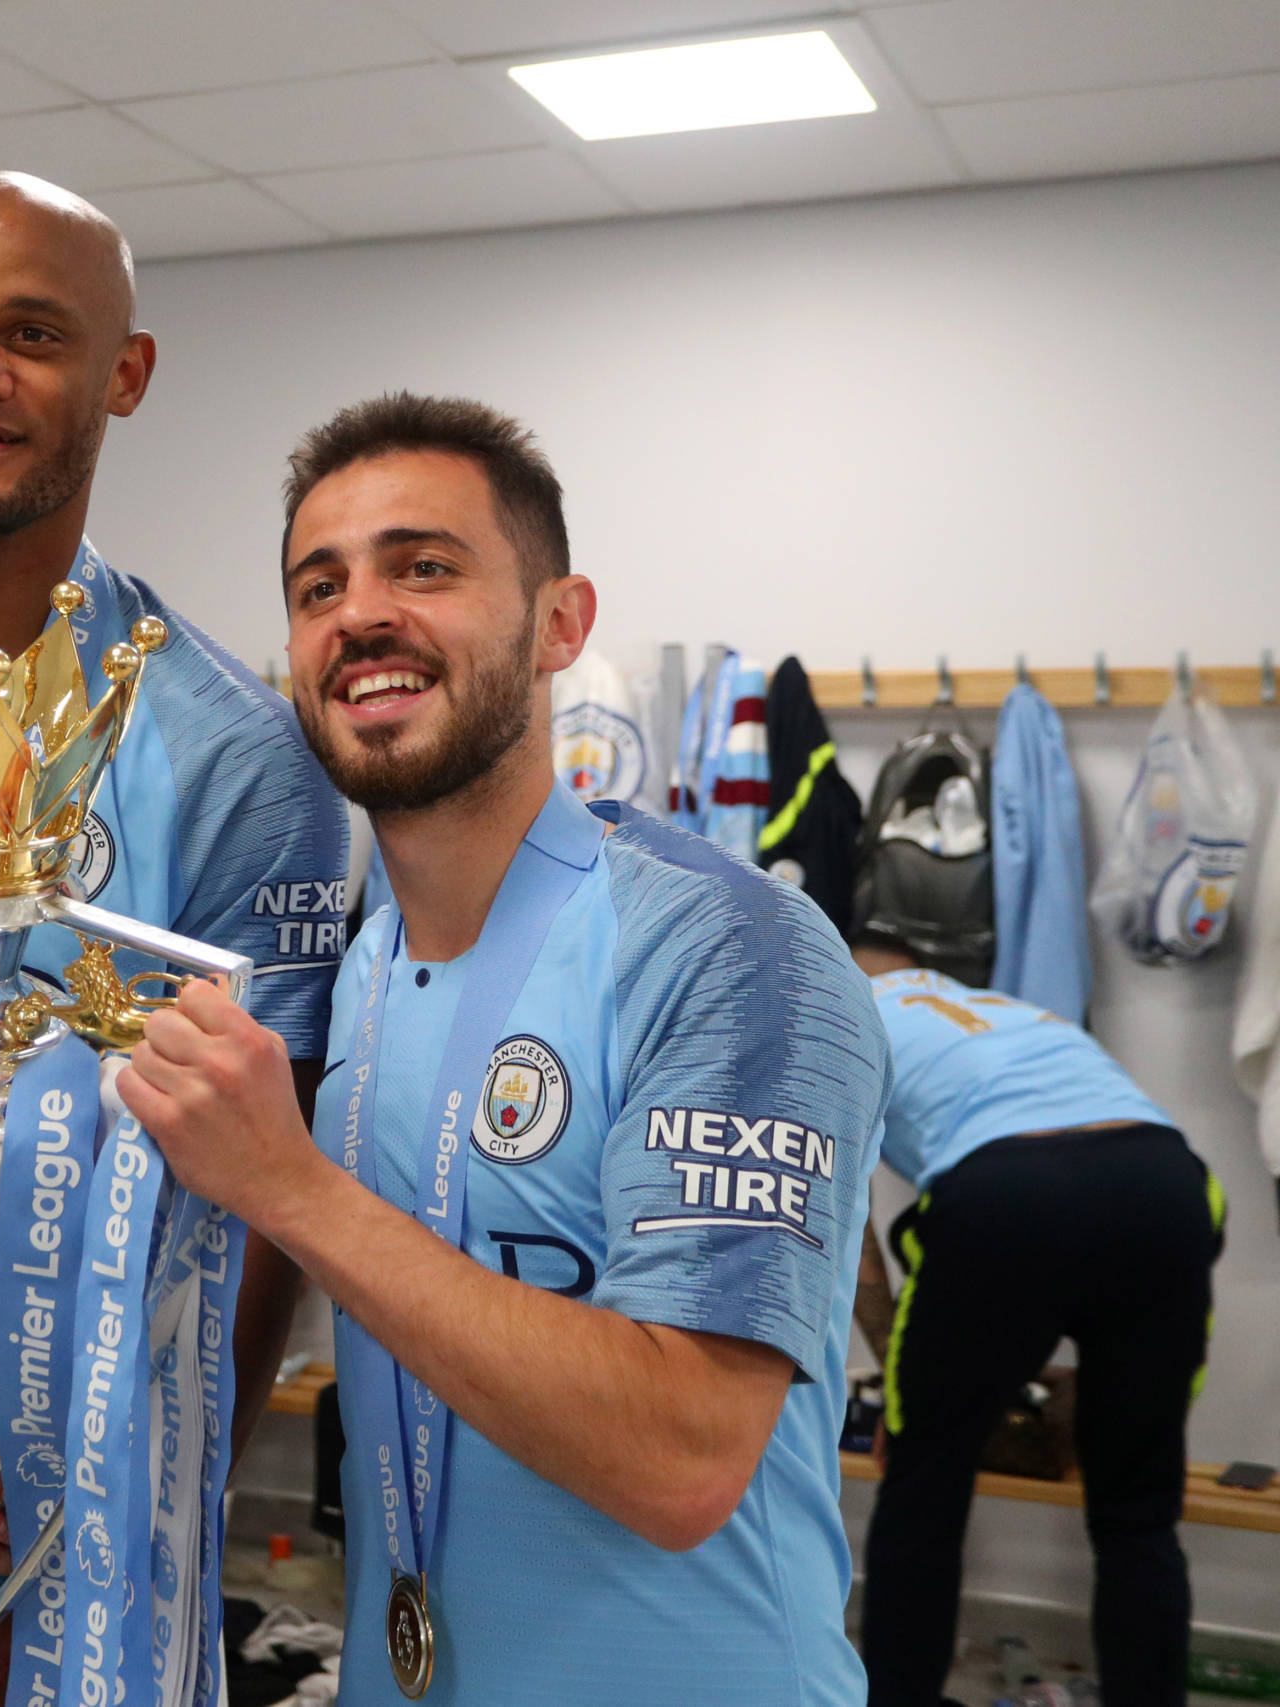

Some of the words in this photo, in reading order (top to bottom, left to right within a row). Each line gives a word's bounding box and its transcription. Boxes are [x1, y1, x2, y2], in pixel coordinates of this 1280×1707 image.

[254, 881, 346, 915] NEXE
[486, 1044, 559, 1086] MANCHESTER
[13, 1089, 81, 1279] League
[91, 1108, 149, 1280] Leagu
[427, 1090, 462, 1218] League
[489, 1140, 519, 1155] CITY
[646, 1109, 835, 1180] NEXEN
[673, 1161, 809, 1225] TIRE
[9, 1286, 56, 1437] Premier
[77, 1290, 124, 1498] Premier
